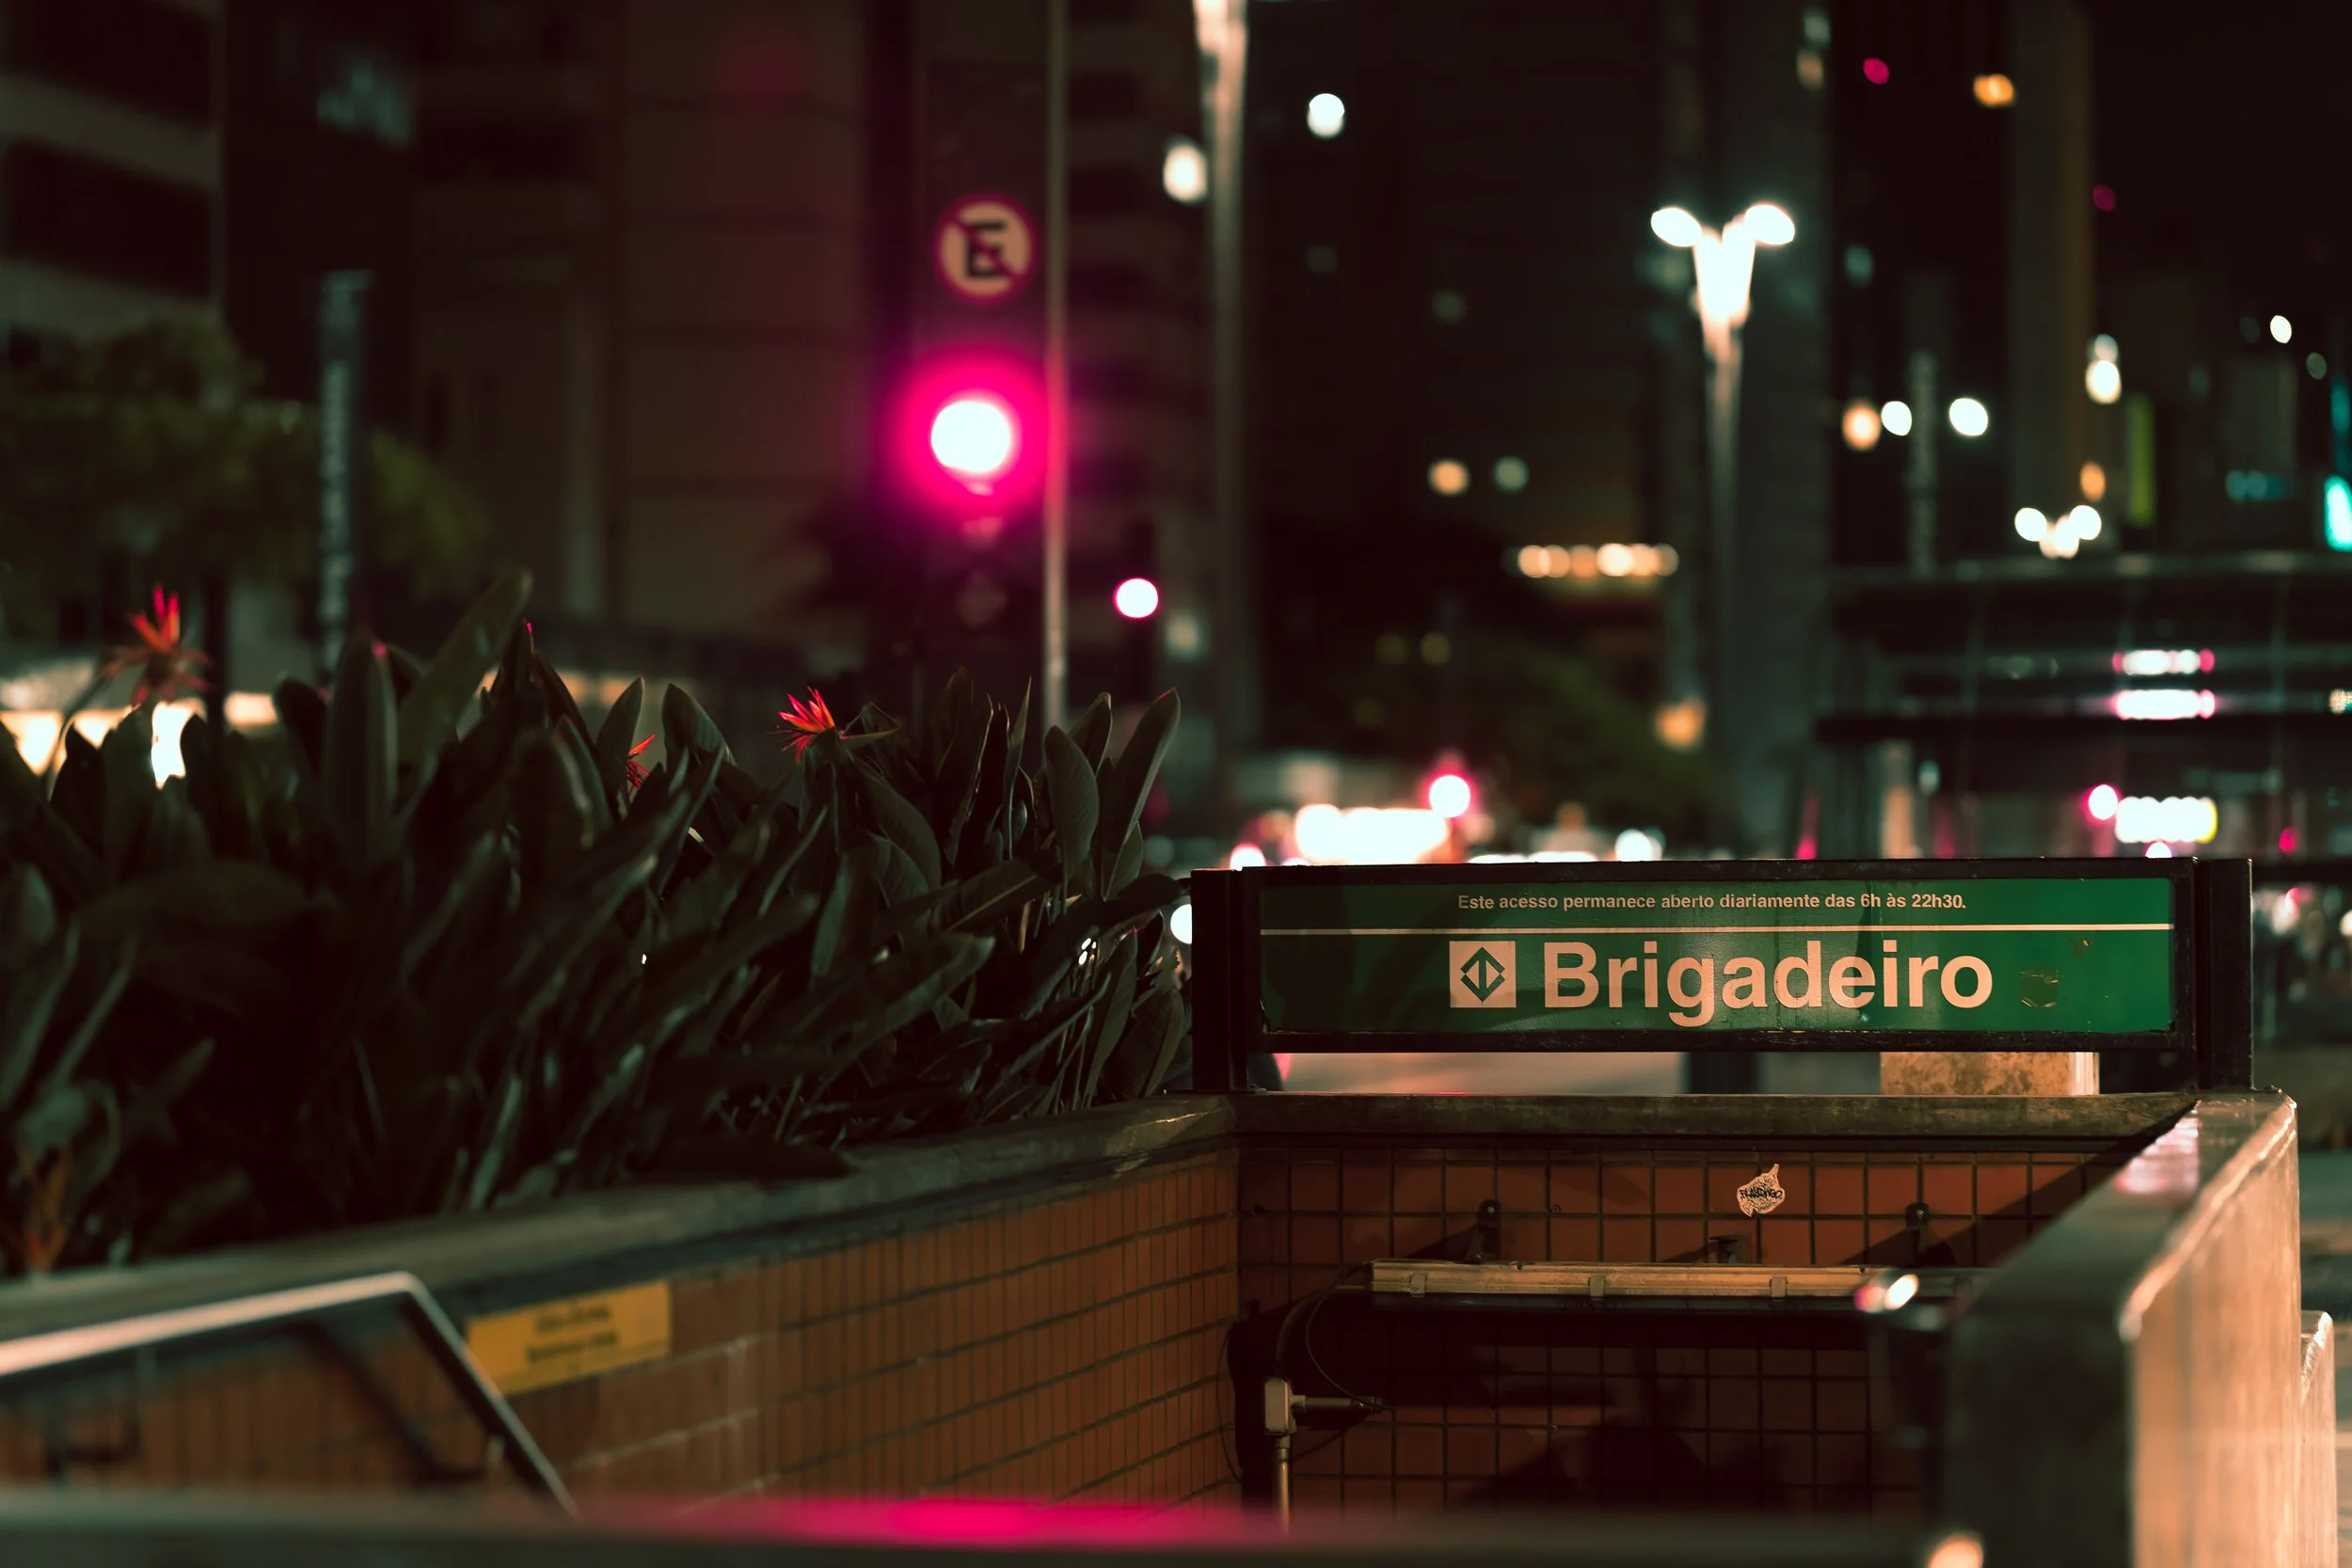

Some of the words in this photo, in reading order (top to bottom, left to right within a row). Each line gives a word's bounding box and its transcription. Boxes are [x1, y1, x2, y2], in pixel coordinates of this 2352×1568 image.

[966, 221, 1005, 278] E
[1460, 895, 1494, 909] Este
[1500, 897, 1558, 909] acesso
[1564, 897, 1655, 911] permanece
[1661, 895, 1714, 909] aberto
[1720, 894, 1820, 909] diariamente
[1825, 894, 1855, 908] das
[1861, 894, 1881, 908] 6h
[1886, 893, 1906, 908] às
[1912, 894, 1966, 909] 22h30.
[1544, 940, 1993, 1027] Brigadeiro
